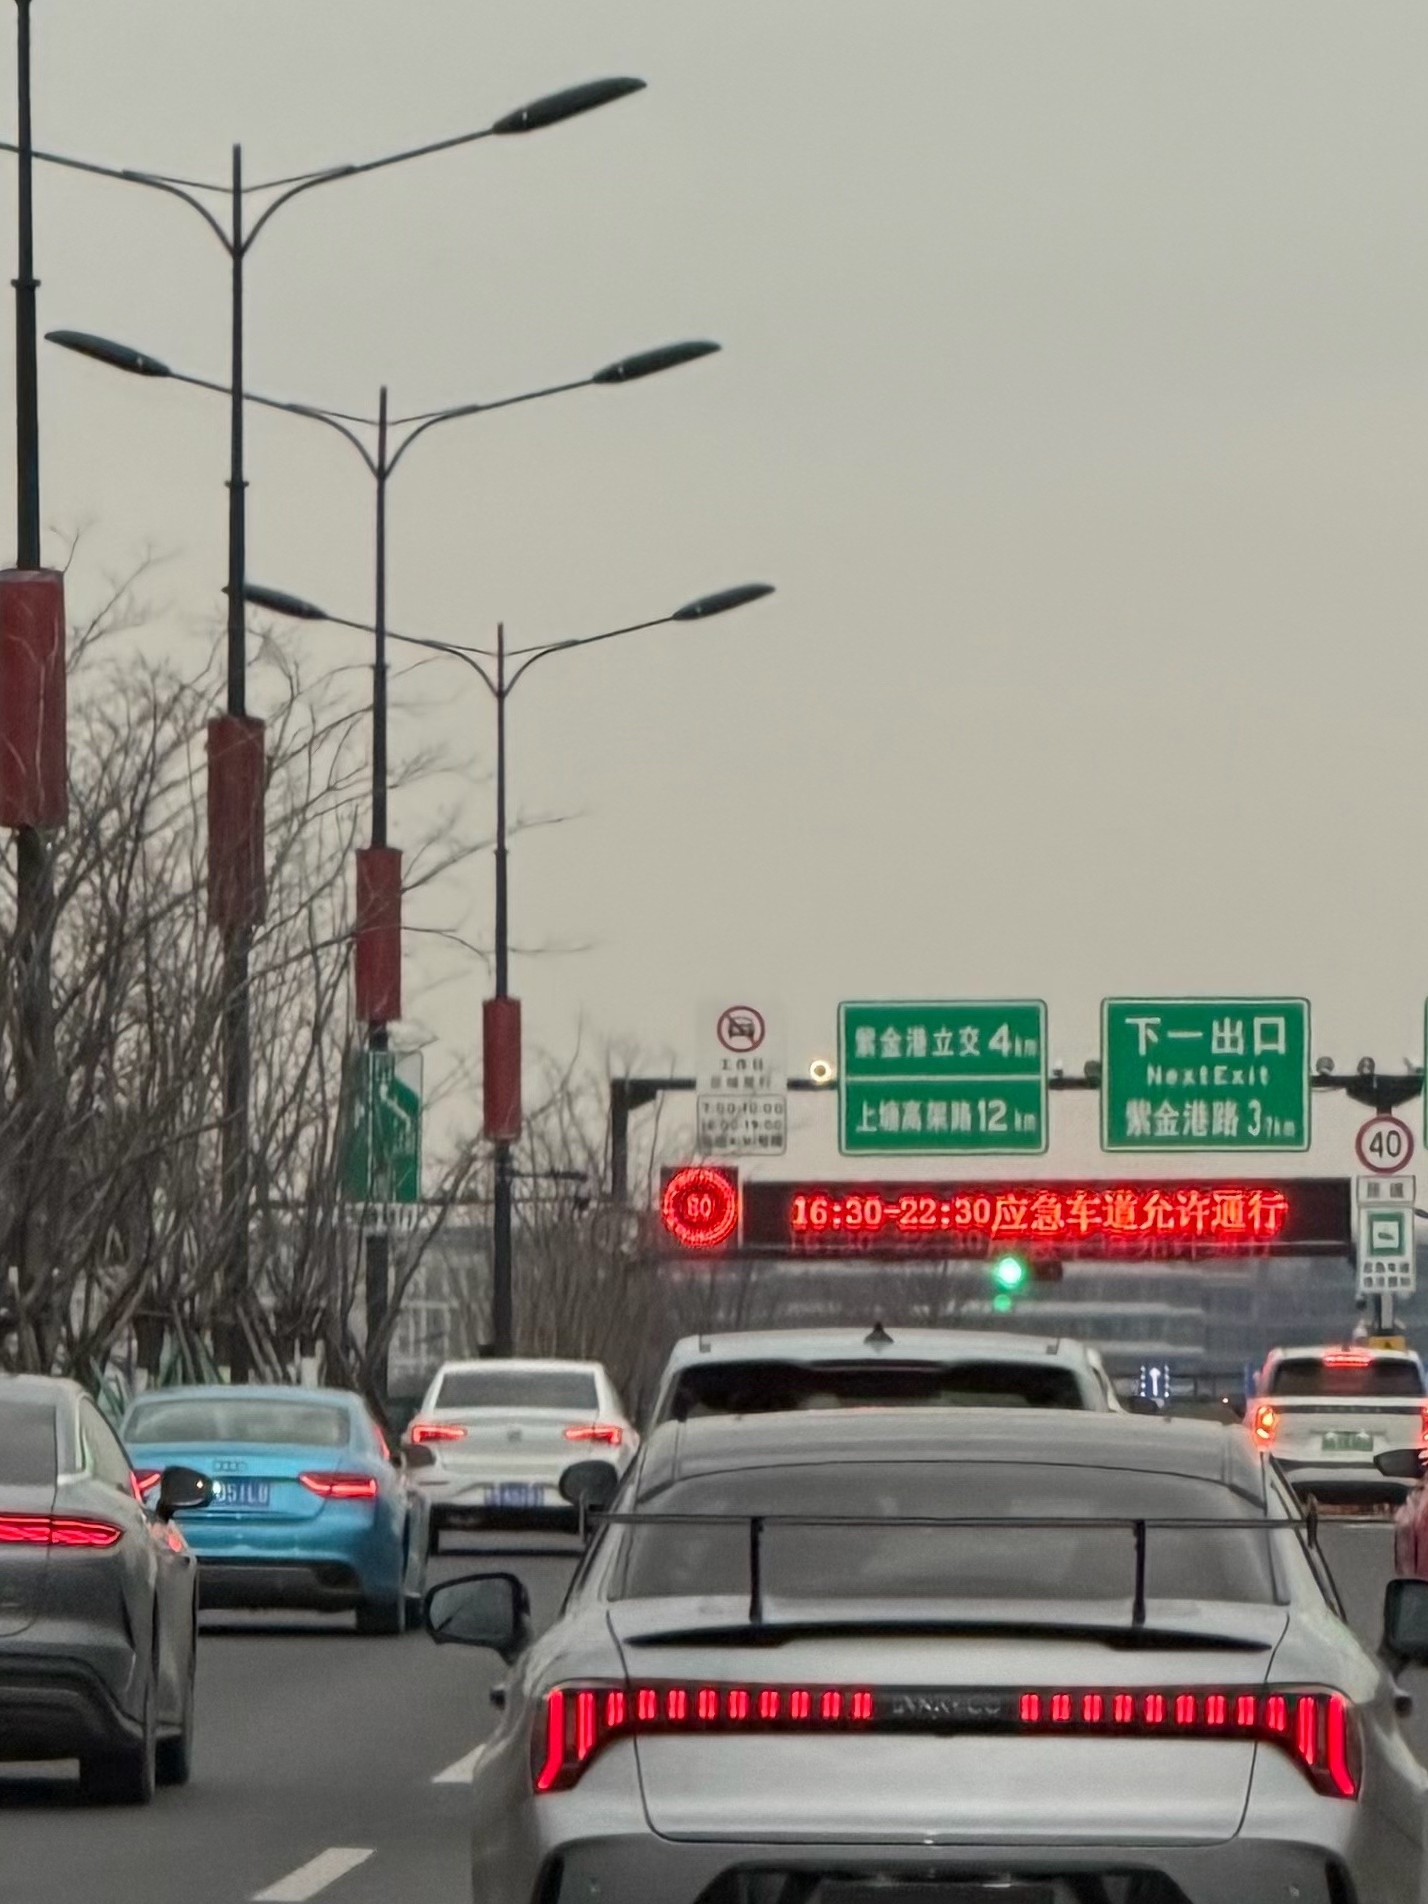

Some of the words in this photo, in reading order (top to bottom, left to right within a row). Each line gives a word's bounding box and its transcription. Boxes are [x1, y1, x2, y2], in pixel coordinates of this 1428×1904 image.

[1125, 1016, 1286, 1056] 下一出口
[1369, 1130, 1402, 1158] 40
